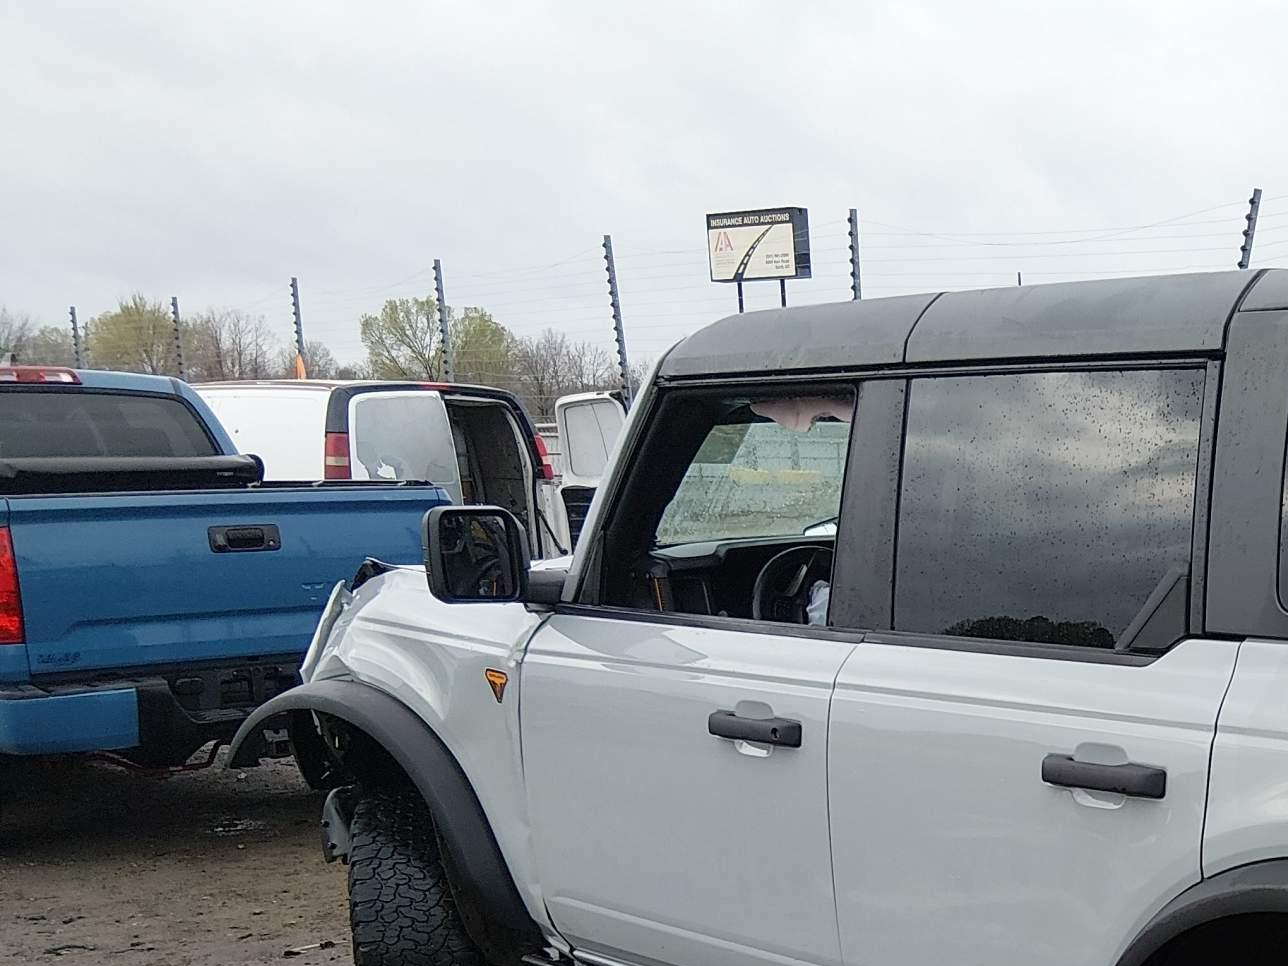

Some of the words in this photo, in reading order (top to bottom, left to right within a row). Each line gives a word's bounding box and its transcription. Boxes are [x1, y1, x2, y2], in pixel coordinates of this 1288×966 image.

[710, 217, 742, 226] INSURANCE
[743, 216, 759, 224] AUTO
[760, 213, 789, 223] AUCTIONS
